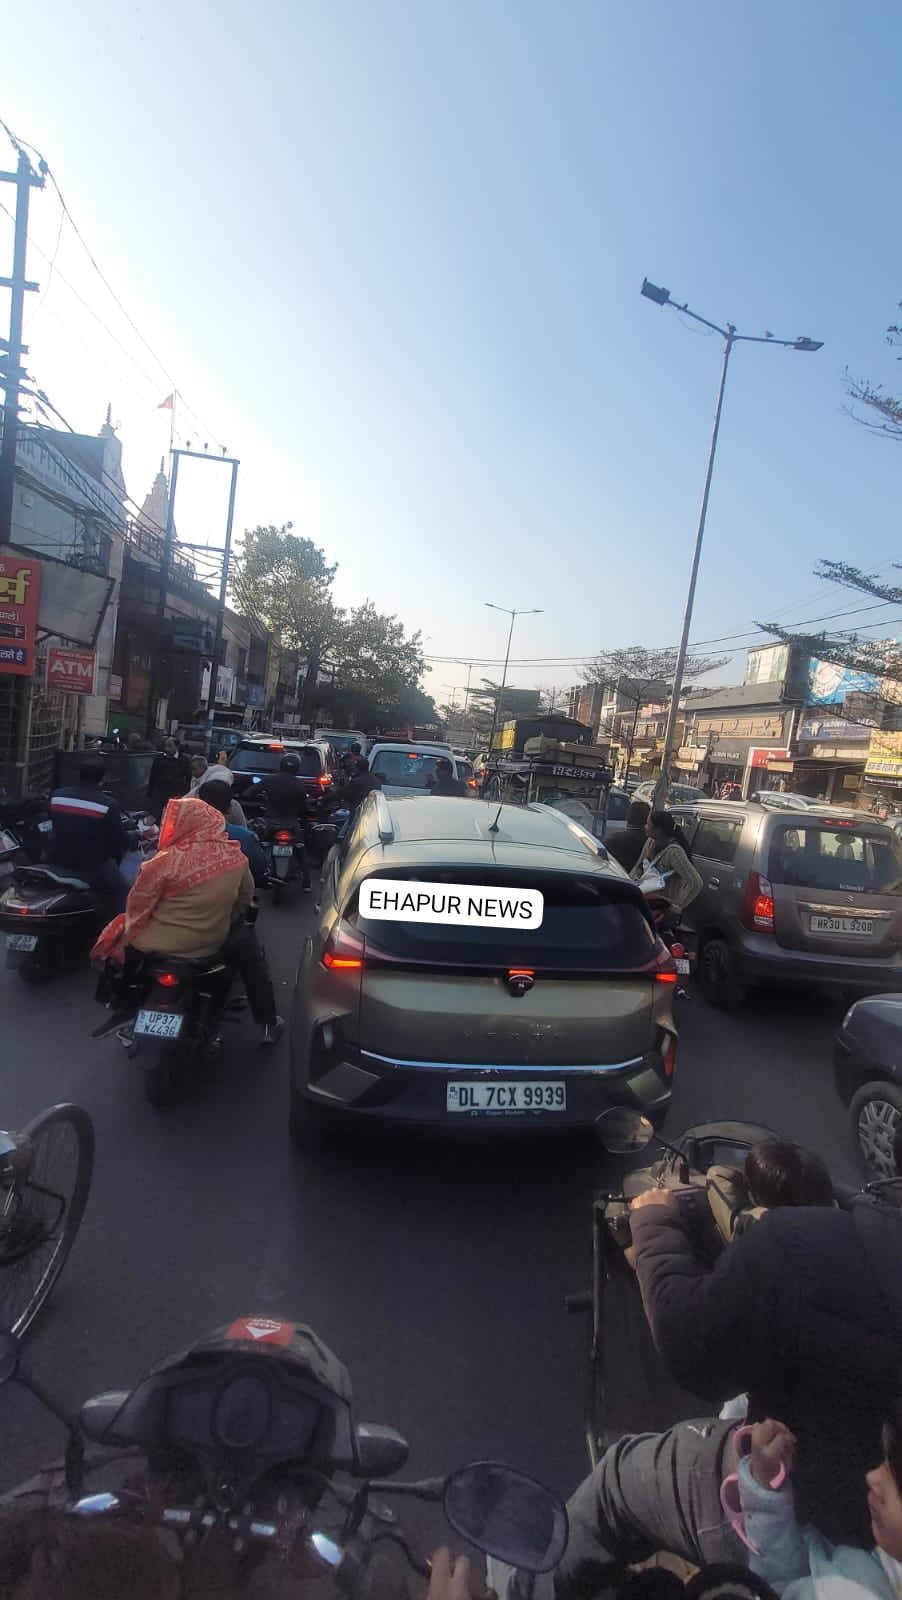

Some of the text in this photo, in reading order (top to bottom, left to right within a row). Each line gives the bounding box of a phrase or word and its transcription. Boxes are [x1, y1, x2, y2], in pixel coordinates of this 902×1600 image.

[50, 659, 93, 678] ATM
[149, 1013, 175, 1025] UP37
[459, 1087, 479, 1107] DL
[485, 1087, 518, 1107] 7CX
[523, 1086, 565, 1106] 9939
